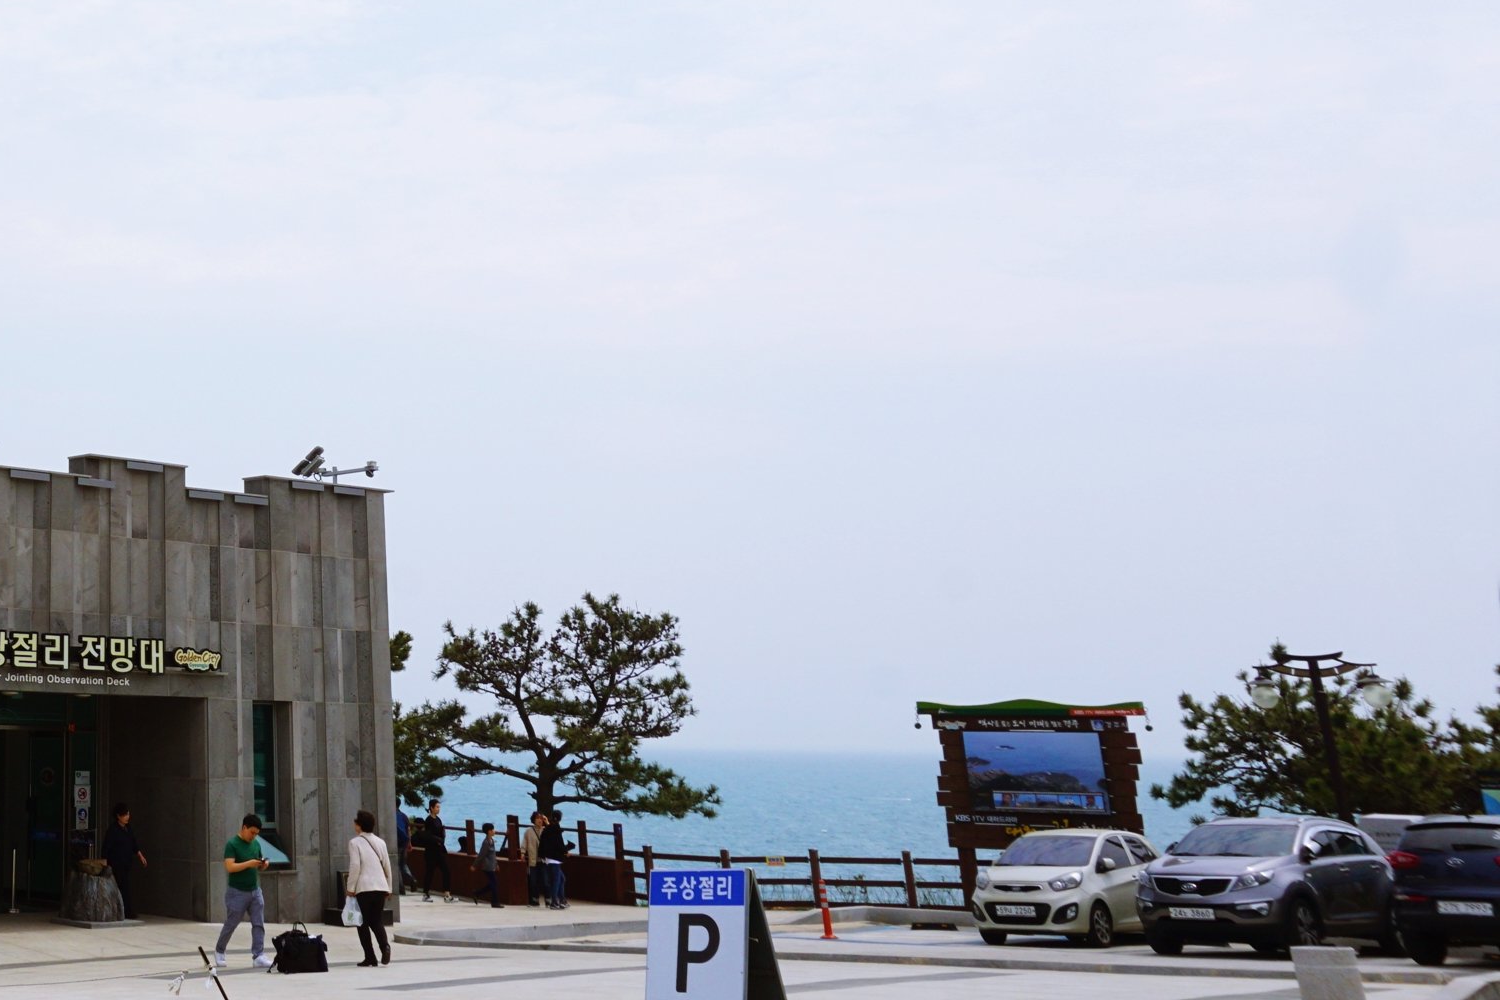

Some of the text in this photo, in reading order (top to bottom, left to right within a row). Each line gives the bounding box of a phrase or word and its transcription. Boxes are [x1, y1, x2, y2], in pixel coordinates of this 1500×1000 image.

[80, 636, 164, 674] 전망대
[175, 649, 221, 669] Golden City
[5, 673, 44, 684] Jointing
[47, 674, 104, 686] Observation
[106, 677, 130, 686] Deck
[955, 814, 971, 822] KBS
[661, 875, 732, 900] 주상절리
[676, 913, 720, 993] P
